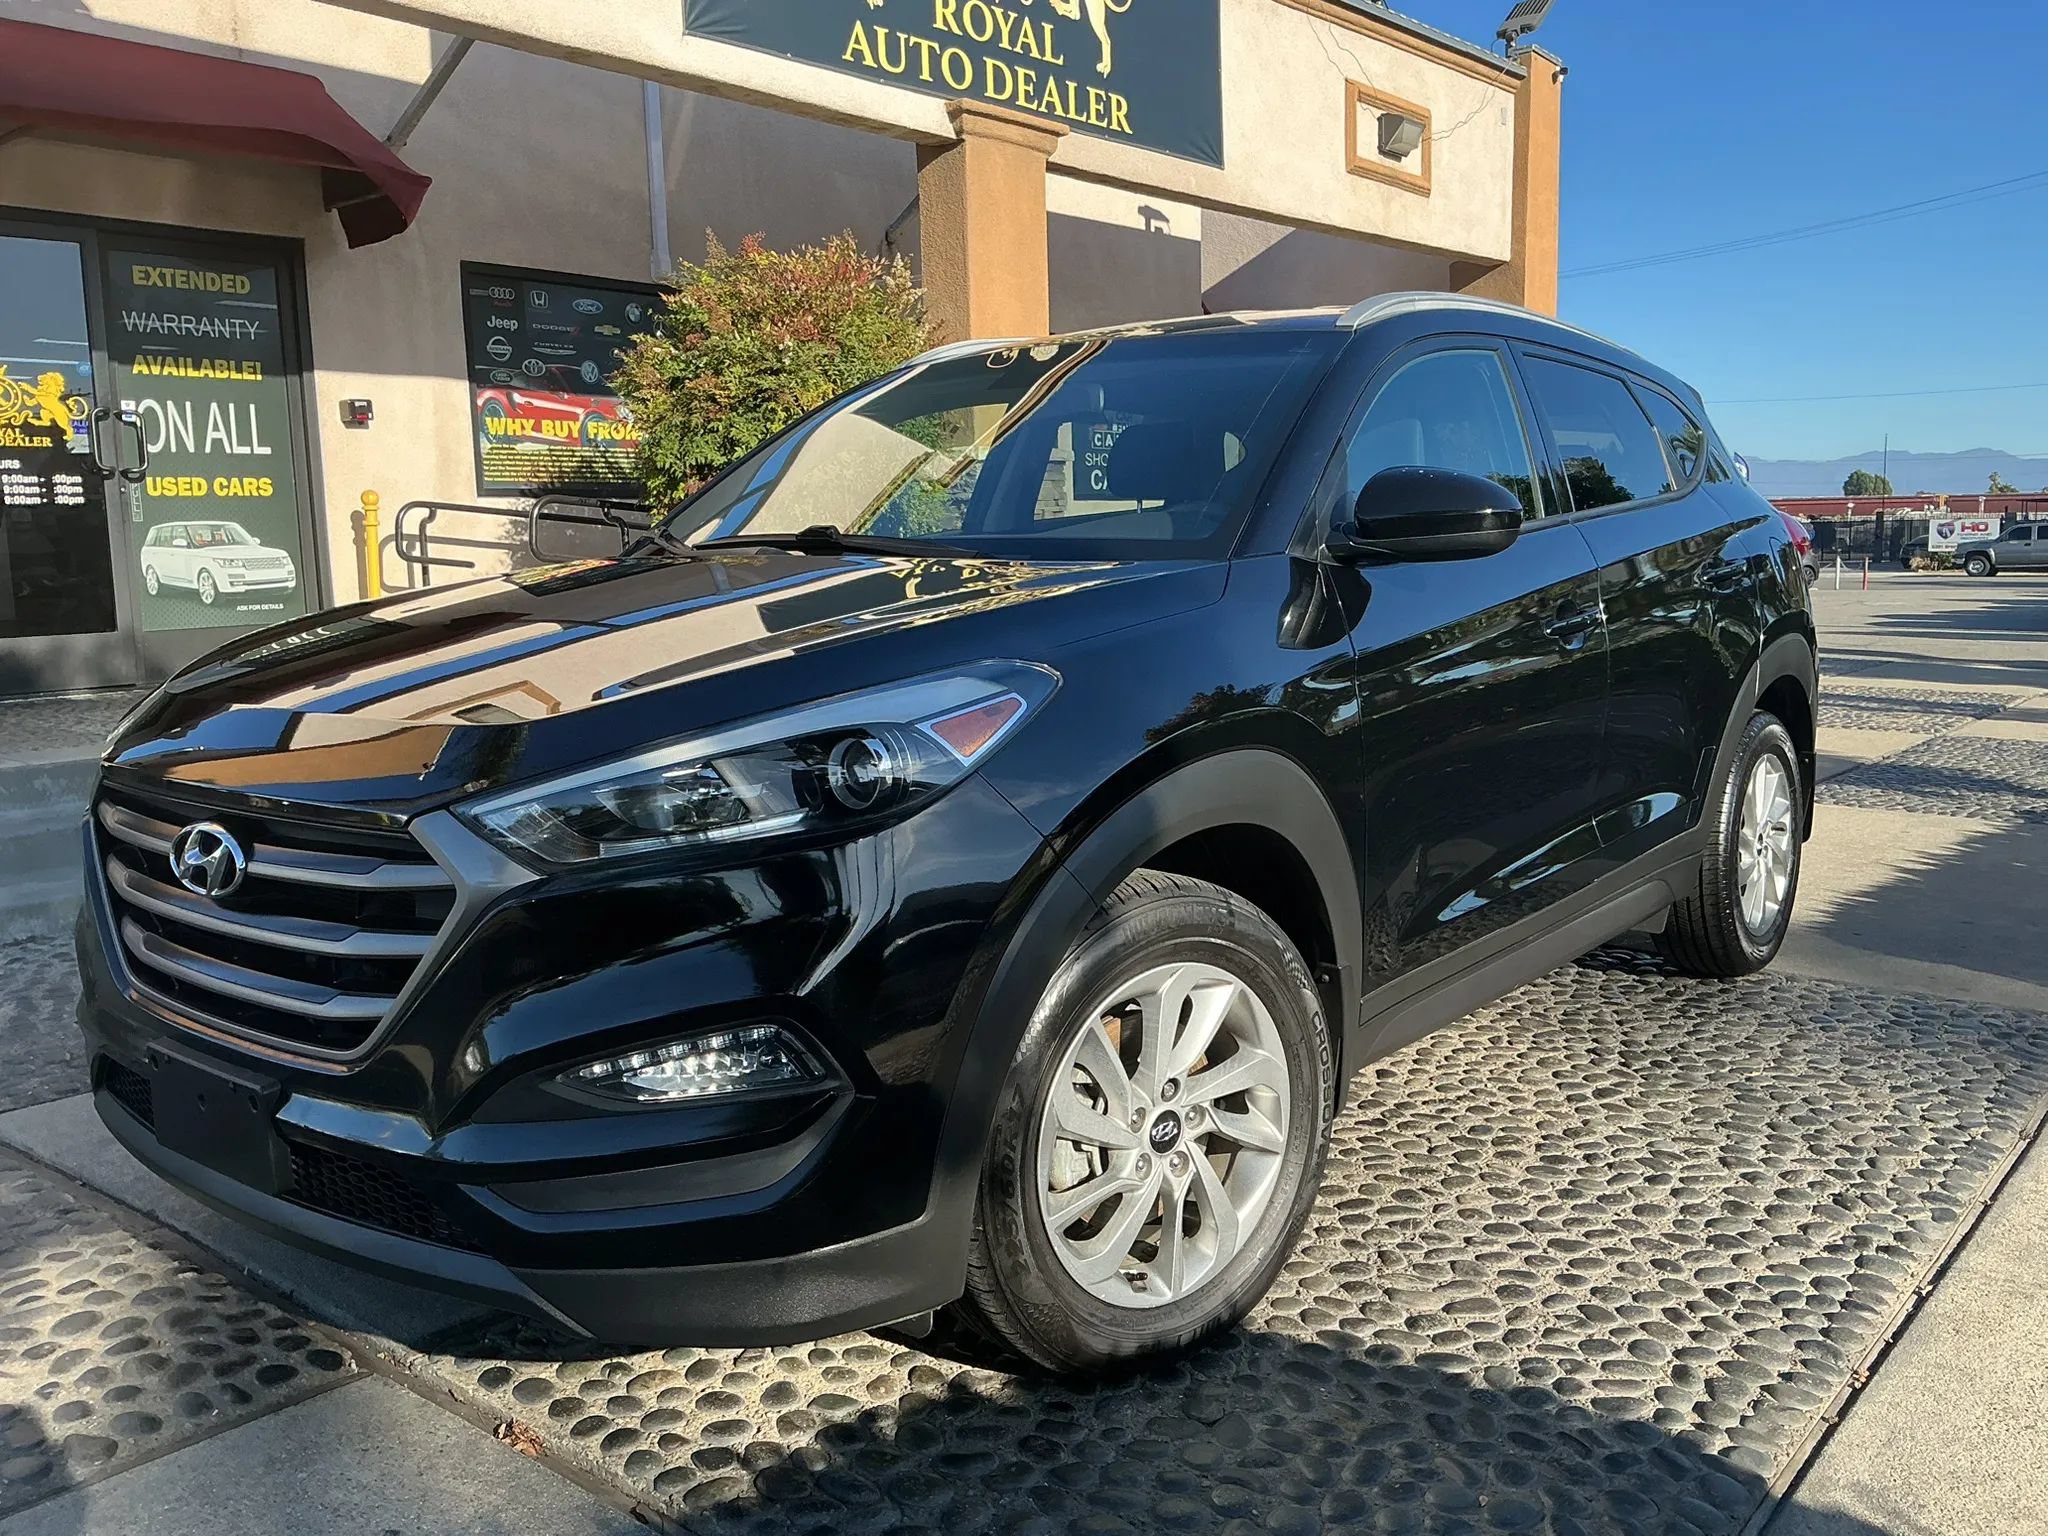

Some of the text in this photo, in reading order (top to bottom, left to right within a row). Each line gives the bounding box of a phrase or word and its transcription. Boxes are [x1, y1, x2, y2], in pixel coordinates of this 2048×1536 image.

[933, 0, 1064, 66] ROYAL
[842, 20, 1133, 134] AUTO DEALER
[132, 265, 250, 295] EXTENDED
[122, 310, 259, 340] WARRANTY
[487, 315, 518, 331] Jeep
[132, 354, 263, 381] AVAILABLE!
[0, 428, 24, 438] YAL
[137, 399, 272, 455] ON ALL
[485, 417, 535, 436] WHY
[541, 420, 581, 438] BUY
[1094, 433, 1119, 447] CA
[0, 460, 20, 469] URS
[1084, 452, 1109, 467] SHO
[146, 477, 273, 497] USED CARS
[1311, 1010, 1333, 1168] CROSSOVE
